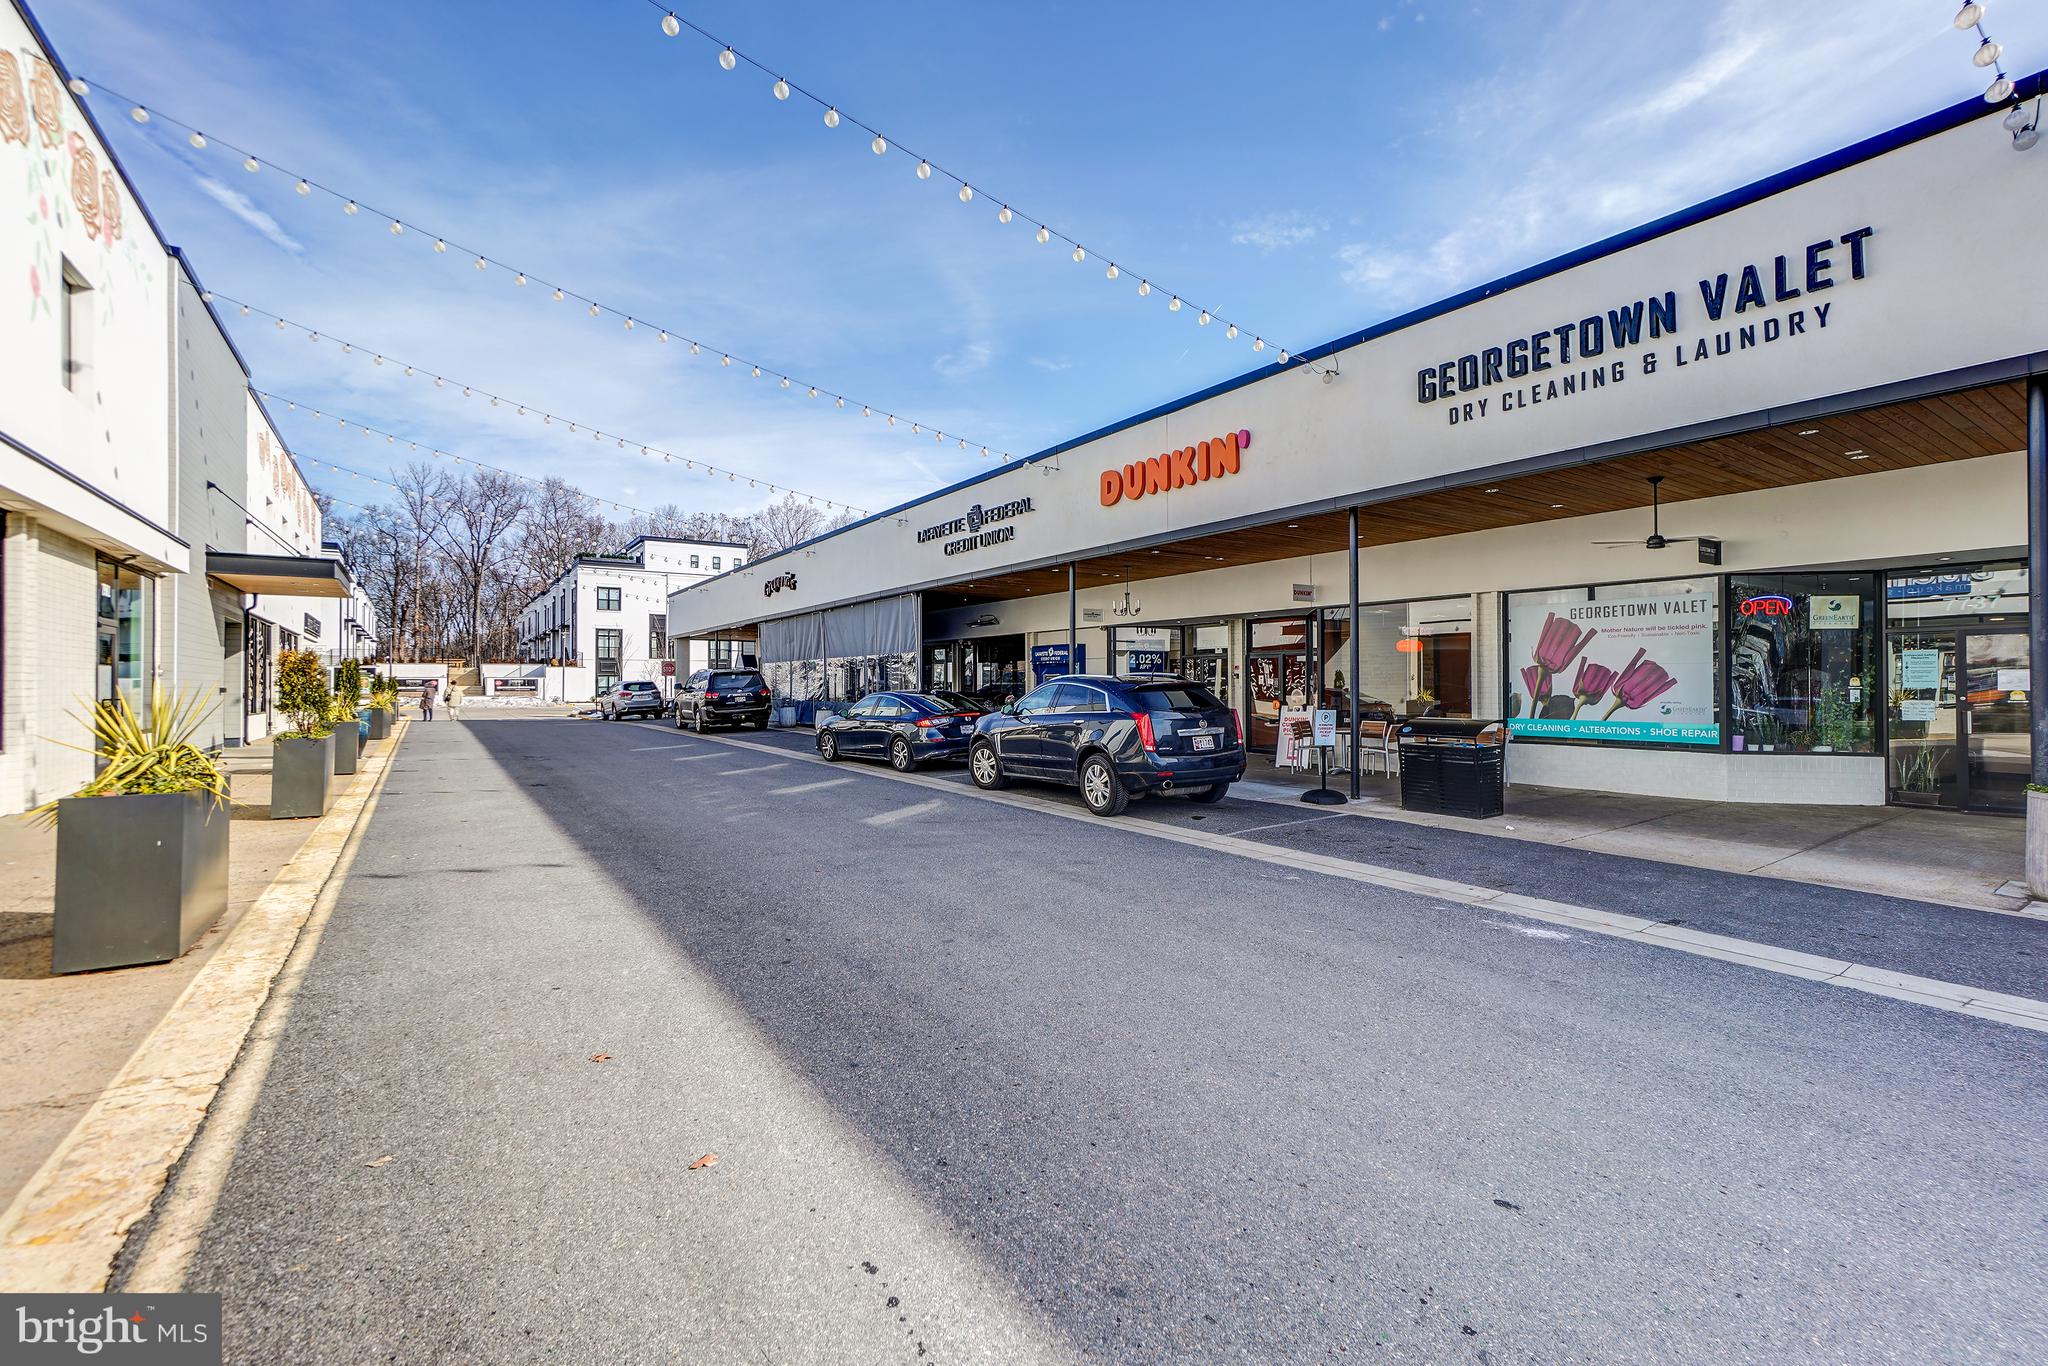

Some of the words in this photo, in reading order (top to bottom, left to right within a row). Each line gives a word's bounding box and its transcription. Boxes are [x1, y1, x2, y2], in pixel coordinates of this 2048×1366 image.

[1418, 291, 1677, 404] GEORGETOWN
[1699, 226, 1873, 320] VALET
[1449, 398, 1488, 425] DRY
[1502, 362, 1624, 412] CLEANING
[1643, 352, 1657, 374] &
[1677, 302, 1831, 367] LAUNDRY
[1100, 430, 1251, 506] DUNKIN'
[917, 517, 966, 543] LAFAYETTE
[984, 497, 1035, 524] FEDERAL
[944, 535, 979, 556] CREDIT
[980, 526, 1014, 547] UNION
[1570, 602, 1657, 620] GEORGETOWN
[1664, 599, 1707, 614] VALET
[1740, 599, 1789, 616] OPEN
[1942, 595, 2001, 611] 7737
[1129, 654, 1161, 664] 2.02%
[1509, 723, 1525, 731] DRY
[1527, 724, 1571, 733] CLEANING
[1579, 725, 1641, 735] ALTERATIONS
[1650, 728, 1678, 737] SHOE
[1681, 729, 1718, 738] REPAIR
